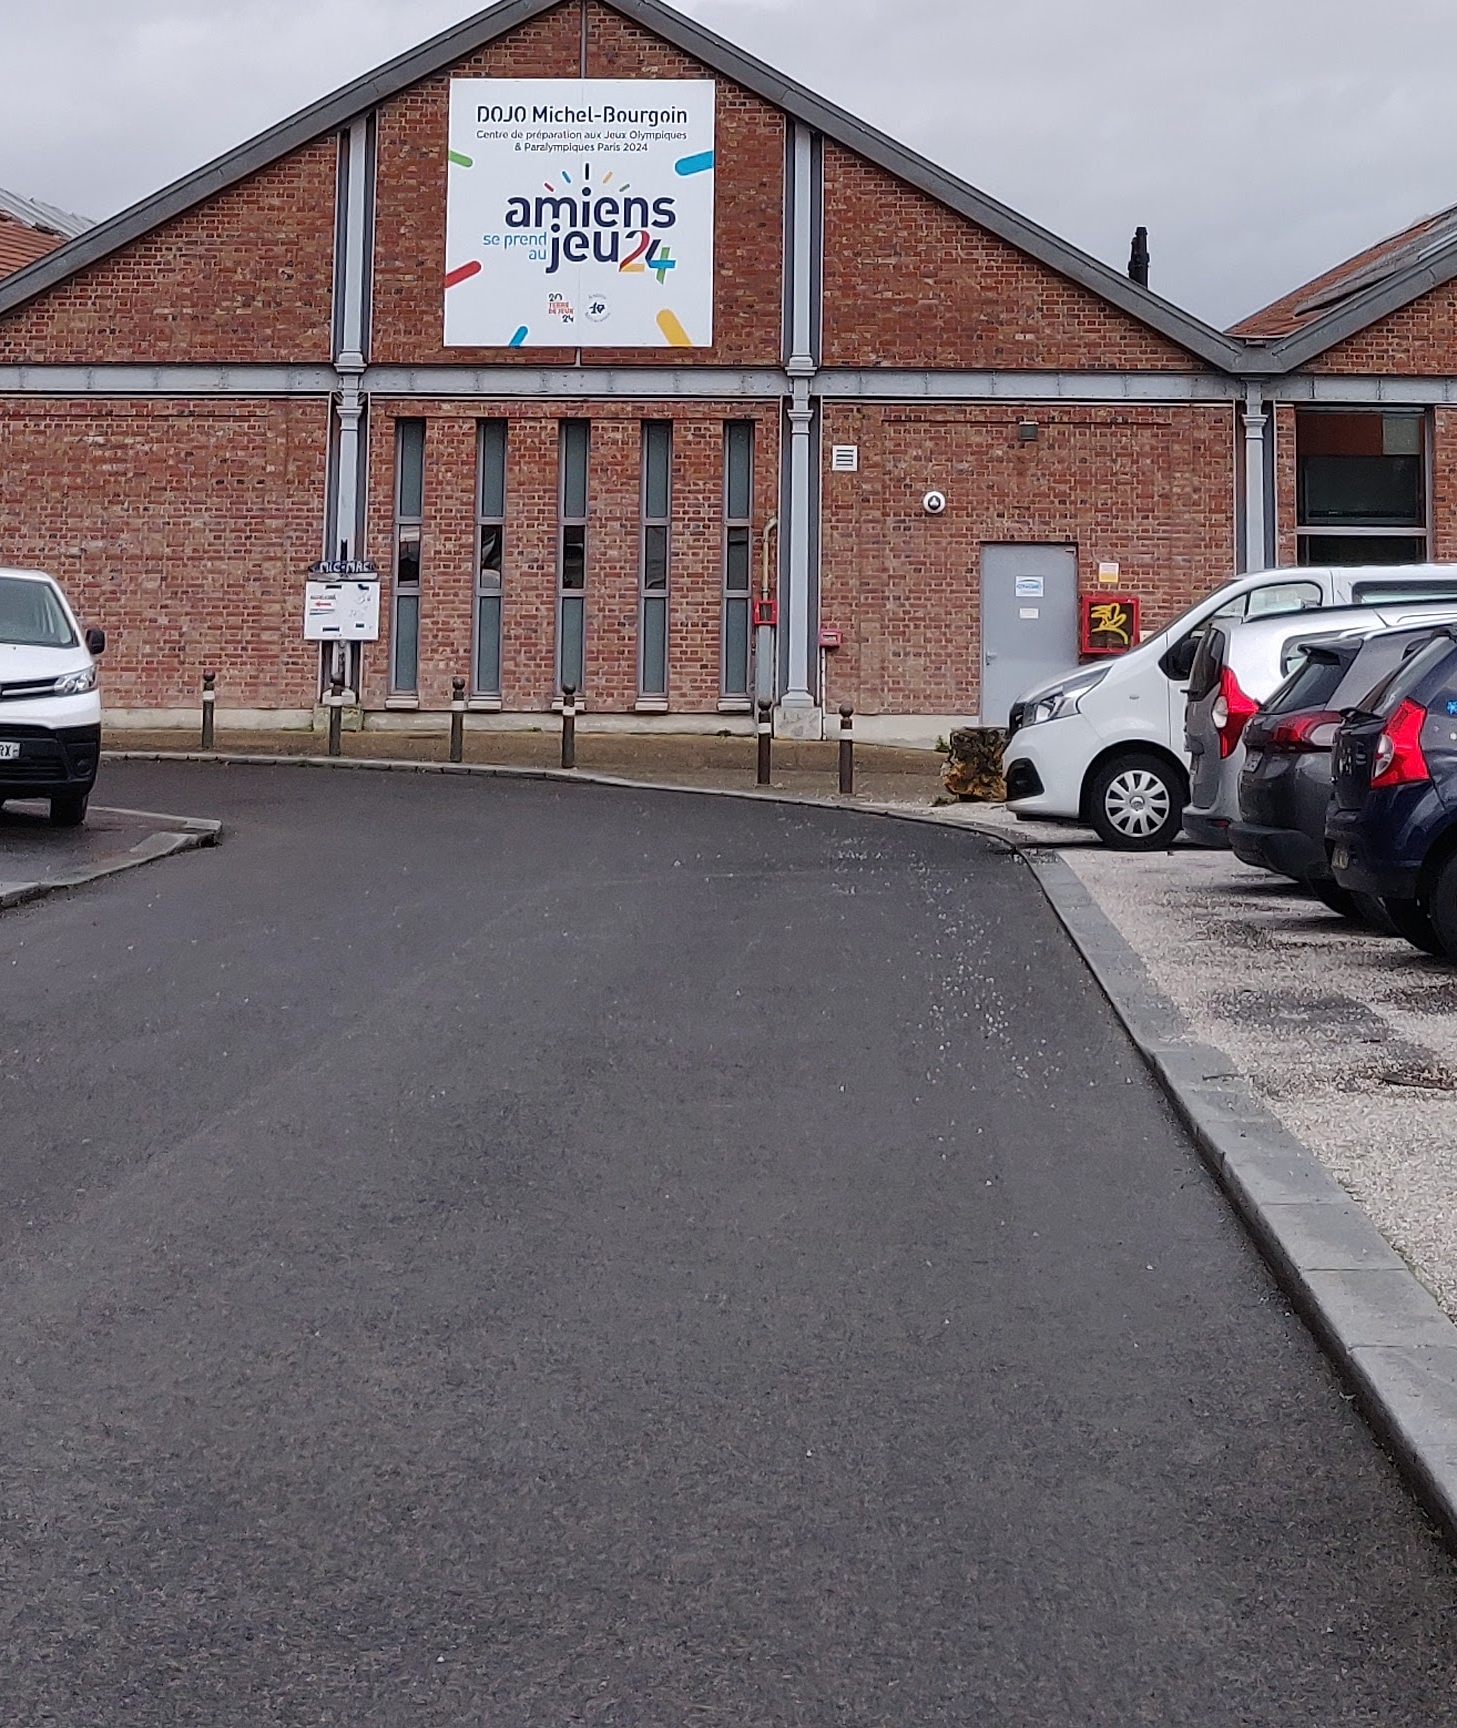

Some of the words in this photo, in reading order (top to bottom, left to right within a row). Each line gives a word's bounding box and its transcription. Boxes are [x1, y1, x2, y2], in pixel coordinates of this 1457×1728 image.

[477, 105, 526, 123] DOJO
[532, 105, 687, 127] Michel-Bourgoin
[476, 130, 509, 140] Centre
[511, 130, 523, 140] de
[526, 129, 582, 143] préparation
[584, 131, 601, 140] aux
[604, 129, 625, 140] Jeux
[629, 129, 687, 143] Olympiques
[514, 143, 522, 152] &
[524, 142, 595, 154] Paralympiques
[597, 142, 621, 152] Paris
[623, 142, 648, 152] 2024
[505, 187, 677, 229] amiens
[483, 234, 500, 246] se
[504, 231, 547, 252] prend
[528, 248, 547, 260] au
